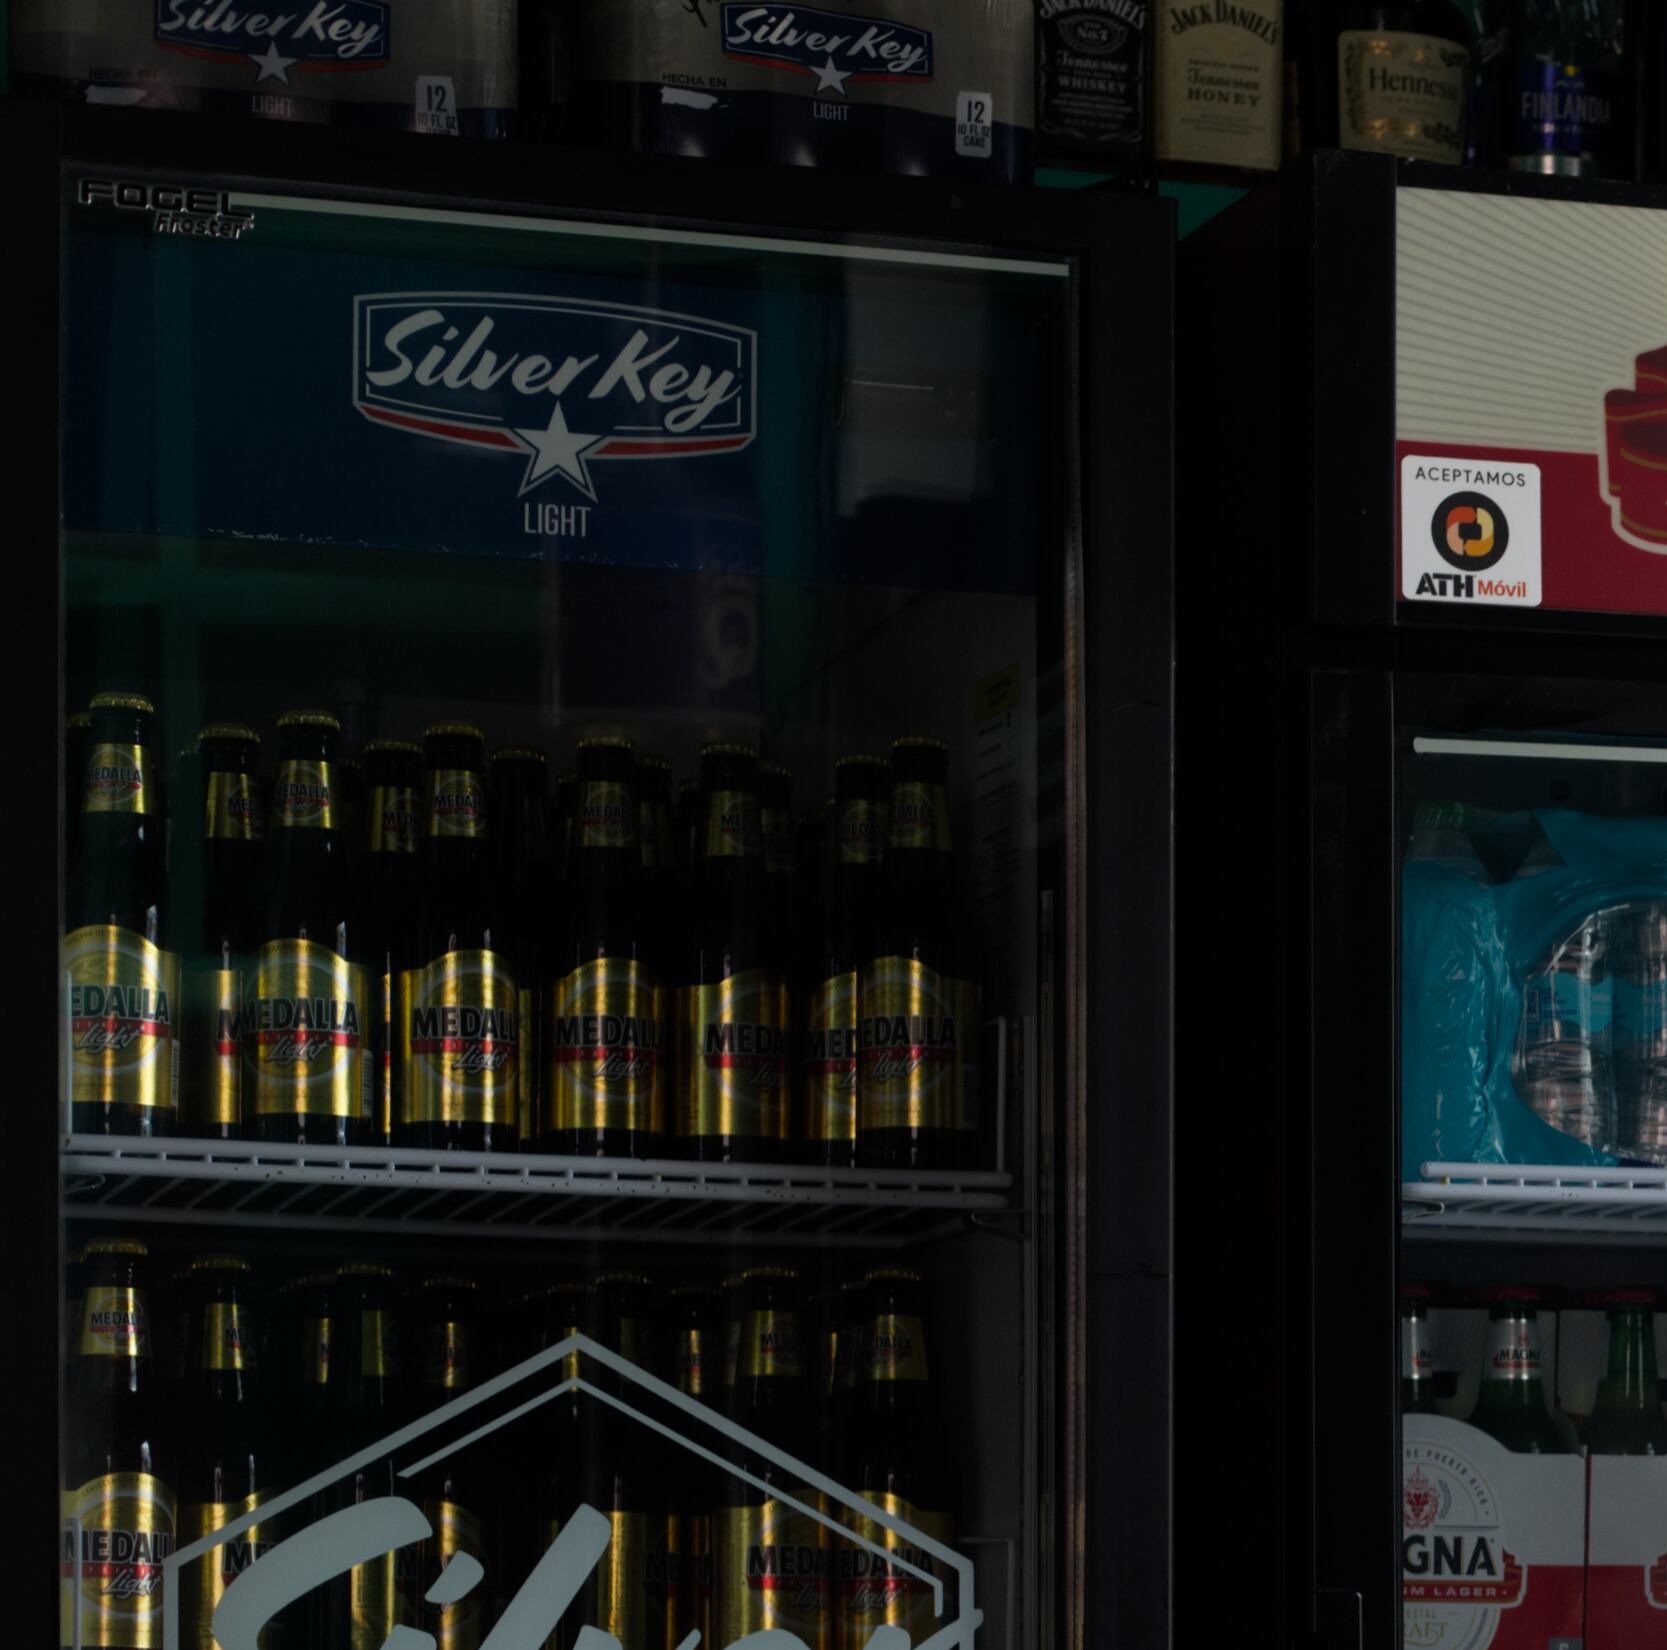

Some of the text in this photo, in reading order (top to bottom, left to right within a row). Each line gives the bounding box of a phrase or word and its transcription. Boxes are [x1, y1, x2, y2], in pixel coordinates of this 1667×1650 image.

[292, 0, 385, 58] Key
[1170, 4, 1214, 35] JACK
[727, 8, 848, 54] Silver
[848, 26, 930, 74] Key
[661, 72, 728, 88] HECHA EN
[1057, 74, 1129, 94] WHISKEY
[252, 95, 293, 118] LIGHT
[427, 85, 447, 113] 12
[1187, 87, 1262, 107] HONEY
[813, 101, 849, 121] LIGHT
[966, 100, 985, 124] 12
[76, 176, 256, 220] FOGEL
[154, 212, 246, 241] Froster
[364, 308, 744, 435] Silver Key
[1415, 466, 1526, 487] ACEPTAMOS
[522, 501, 593, 539] LIGHT
[1416, 572, 1526, 598] ATH Móvil
[265, 1034, 331, 1063] Light
[1433, 1587, 1502, 1598] LAGER
